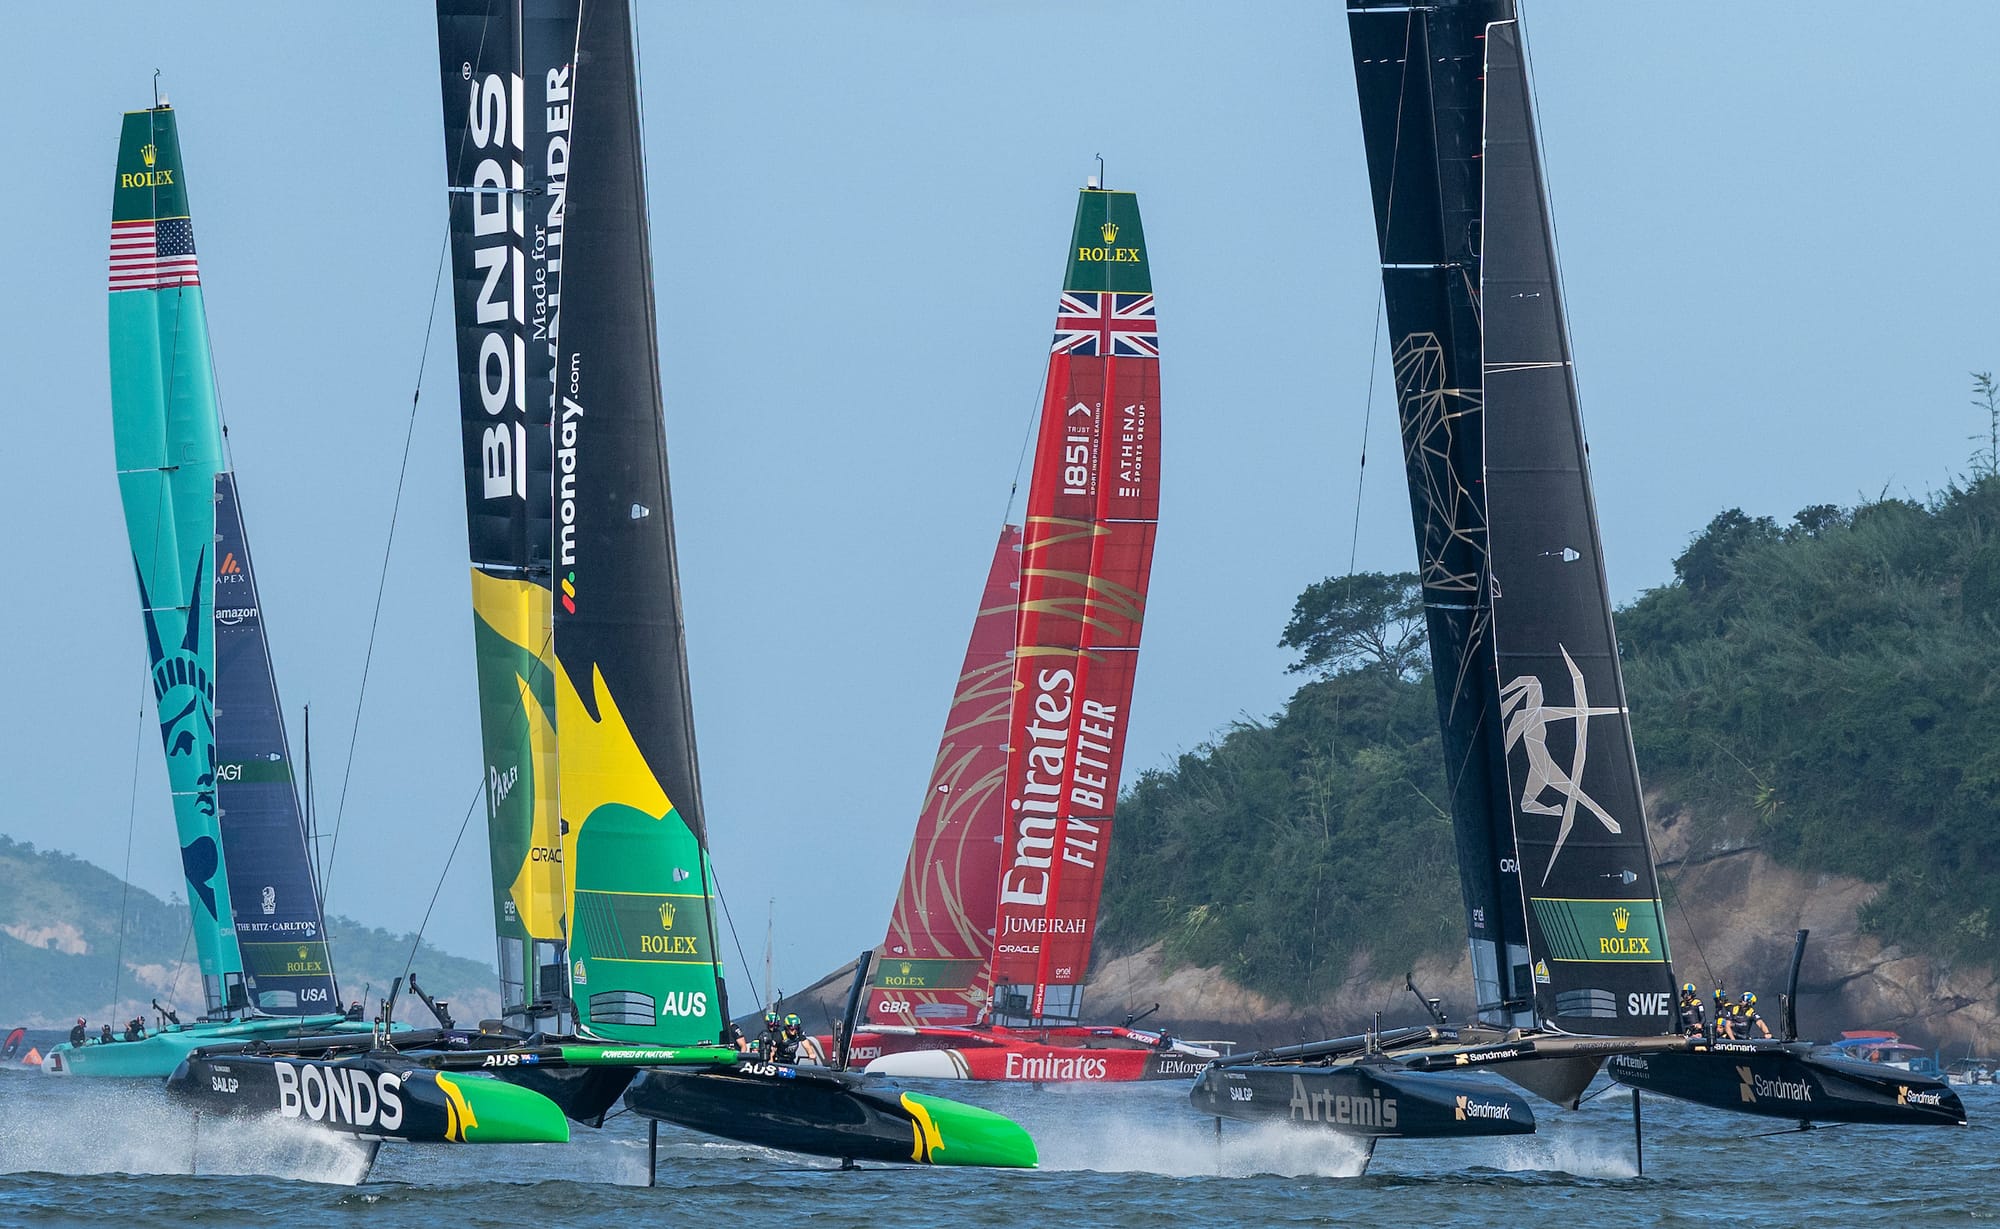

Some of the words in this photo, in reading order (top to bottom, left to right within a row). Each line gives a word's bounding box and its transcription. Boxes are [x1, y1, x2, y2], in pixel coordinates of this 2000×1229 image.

[121, 170, 174, 188] ROLEX
[532, 224, 546, 261] for
[1078, 247, 1141, 262] ROLEX
[470, 73, 512, 500] BONDS
[532, 267, 546, 342] Made
[1094, 402, 1102, 437] LEARNING
[1137, 404, 1146, 440] GROUP
[1120, 404, 1136, 482] ATHENA
[558, 352, 584, 565] monday.com
[1063, 436, 1090, 495] 1851
[1134, 444, 1143, 482] SPORTS
[215, 574, 245, 584] APEX
[215, 608, 257, 619] amazon
[1070, 699, 1117, 810] BETTER
[216, 764, 242, 780] AG1
[490, 765, 518, 818] PARLEY
[1000, 668, 1075, 906] Emirates
[1062, 814, 1100, 868] FLY
[531, 847, 562, 863] ORAC
[236, 923, 250, 931] THE
[1002, 915, 1087, 937] JUMEIRAH
[640, 935, 698, 954] ROLEX
[998, 944, 1040, 954] ORACLE
[1599, 937, 1651, 954] ROLEX
[287, 961, 321, 972] ROLEX
[885, 977, 925, 986] ROLEX
[301, 988, 328, 1002] USA
[661, 991, 707, 1017] AUS
[1627, 992, 1671, 1017] SWE
[879, 1001, 911, 1013] GBR
[601, 1050, 636, 1059] POWERED
[635, 1050, 646, 1059] BY
[850, 1046, 882, 1060] WDEN
[1469, 1048, 1519, 1062] Sandmark
[1714, 1043, 1757, 1052] andmark
[482, 1053, 520, 1067] AUS
[739, 1062, 777, 1076] AUS
[1005, 1052, 1107, 1079] Emirates
[1157, 1060, 1208, 1077] J.P.Morga
[274, 1061, 404, 1131] BONDS
[1754, 1073, 1812, 1102] Sandmark
[1289, 1074, 1397, 1128] Artemis
[1906, 1090, 1941, 1106] Sandmark
[1466, 1099, 1511, 1120] Sandmark
